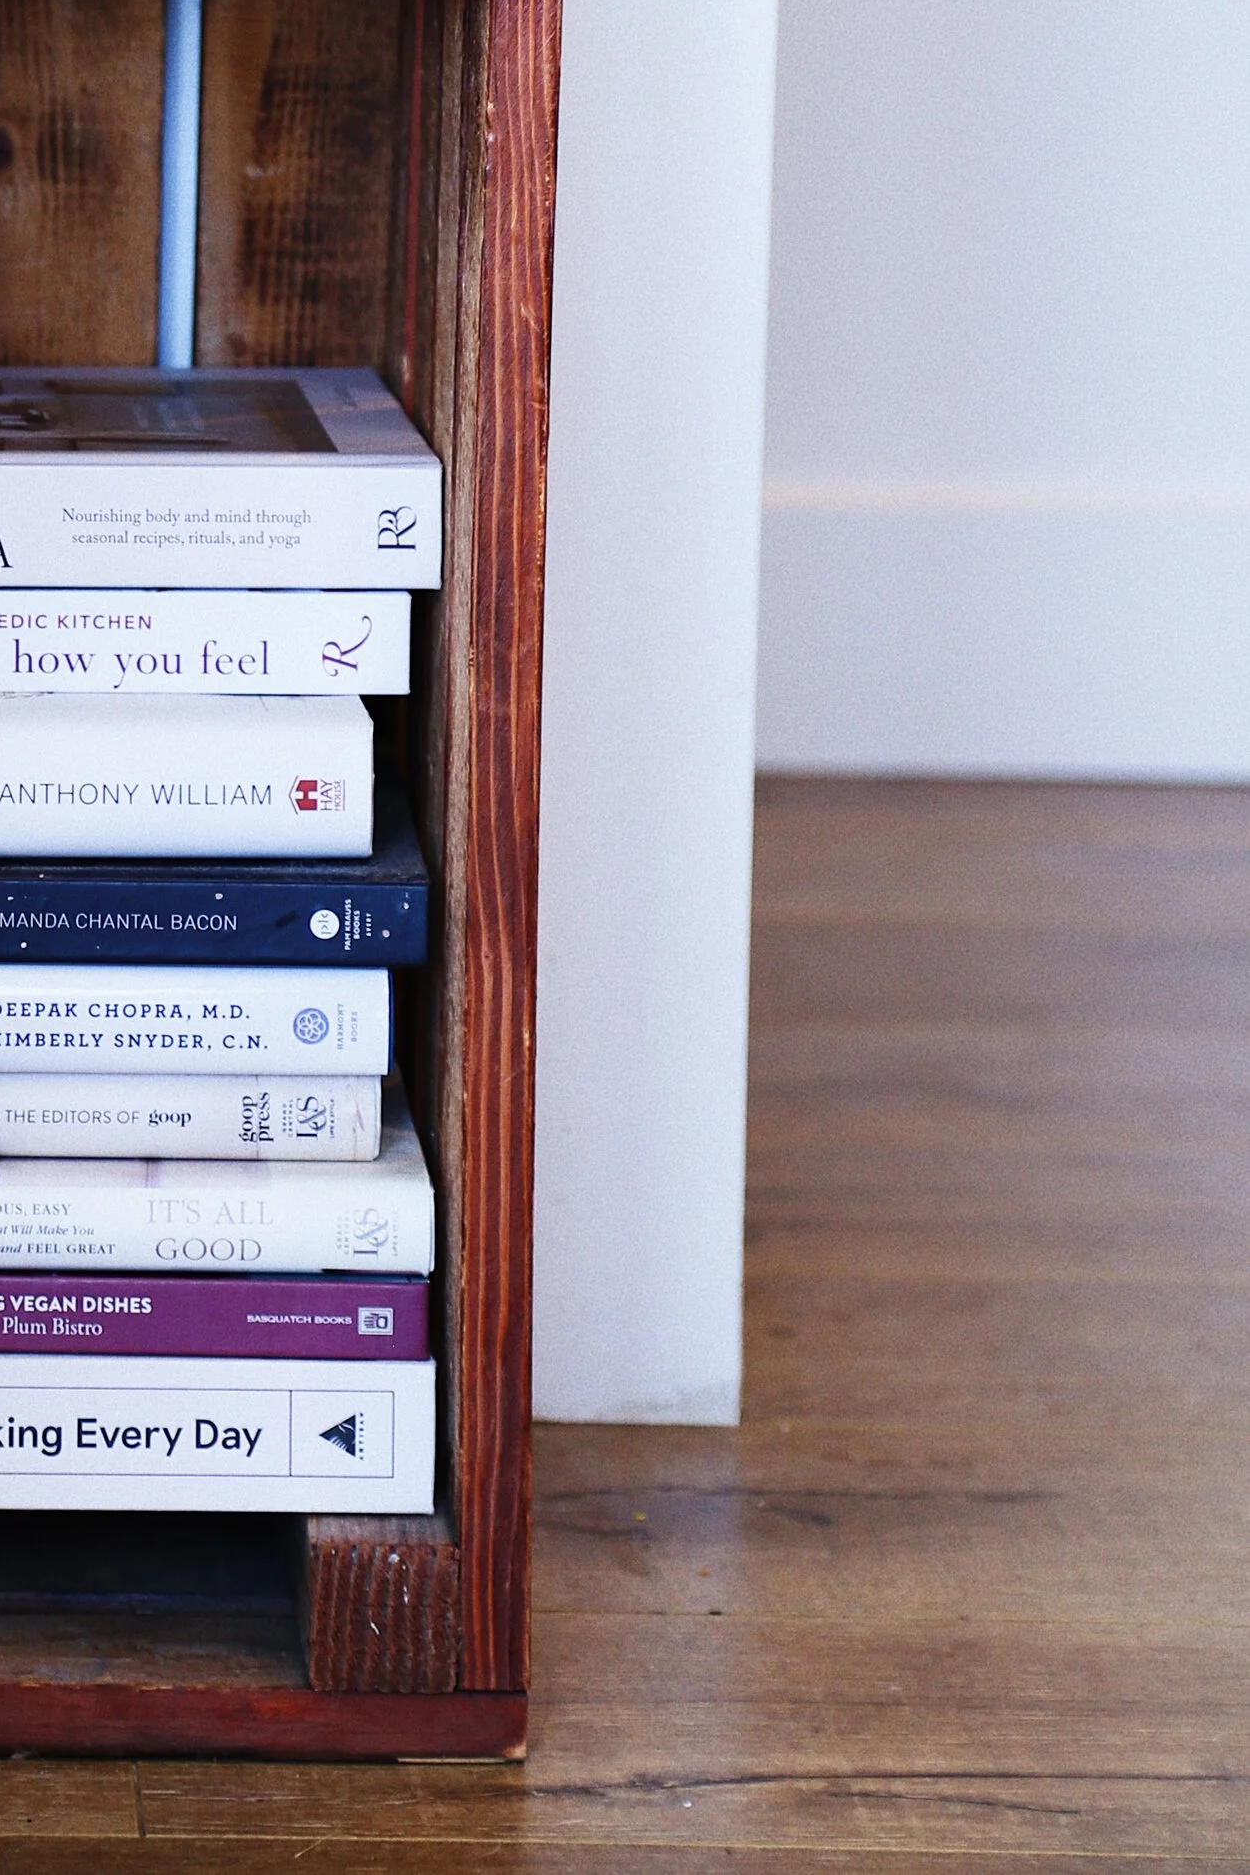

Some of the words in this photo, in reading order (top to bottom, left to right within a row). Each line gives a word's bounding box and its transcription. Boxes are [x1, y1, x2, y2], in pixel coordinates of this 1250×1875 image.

[62, 508, 141, 527] Nourishing
[145, 508, 181, 527] body
[184, 508, 210, 524] and
[214, 508, 252, 524] mind
[256, 509, 311, 527] through
[71, 530, 129, 544] seasonal
[133, 531, 185, 549] recipes,
[189, 530, 236, 547] rituals,
[238, 531, 265, 545] and
[268, 534, 300, 549] yoga
[57, 614, 152, 630] KITCHEN
[13, 638, 96, 674] how
[113, 650, 182, 689] you
[202, 639, 270, 676] feel
[152, 784, 272, 806] WILLIAM
[320, 779, 333, 811] HAY
[334, 780, 342, 811] HOUSE
[76, 912, 165, 930] CHANTAL
[170, 914, 238, 931] BACON
[344, 899, 352, 931] KRAUSS
[353, 910, 361, 939] BOOKS
[88, 1002, 193, 1022] CHOPRA,
[202, 1004, 250, 1019] M.D.
[114, 1033, 213, 1052] SNYDER,
[224, 1035, 268, 1050] C.N.
[6, 1109, 36, 1123] THE
[42, 1109, 111, 1124] EDITORS
[117, 1109, 140, 1124] OF
[149, 1110, 191, 1127] goop
[239, 1096, 257, 1142] goop
[259, 1092, 274, 1141] press
[33, 1204, 71, 1215] EASY
[214, 1201, 274, 1224] ALL
[10, 1224, 34, 1235] Will
[36, 1224, 69, 1235] Make
[73, 1225, 94, 1236] You
[27, 1243, 61, 1254] FEEL
[66, 1243, 116, 1255] GREAT
[155, 1238, 263, 1261] GOOD
[10, 1296, 77, 1313] VEGAN
[82, 1297, 152, 1314] DISHES
[2, 1317, 47, 1335] Plum
[52, 1317, 103, 1336] Bistro
[247, 1314, 311, 1325] SASQUATCH
[314, 1315, 352, 1325] BOOKS
[77, 1418, 182, 1456] Every
[195, 1419, 262, 1457] Day
